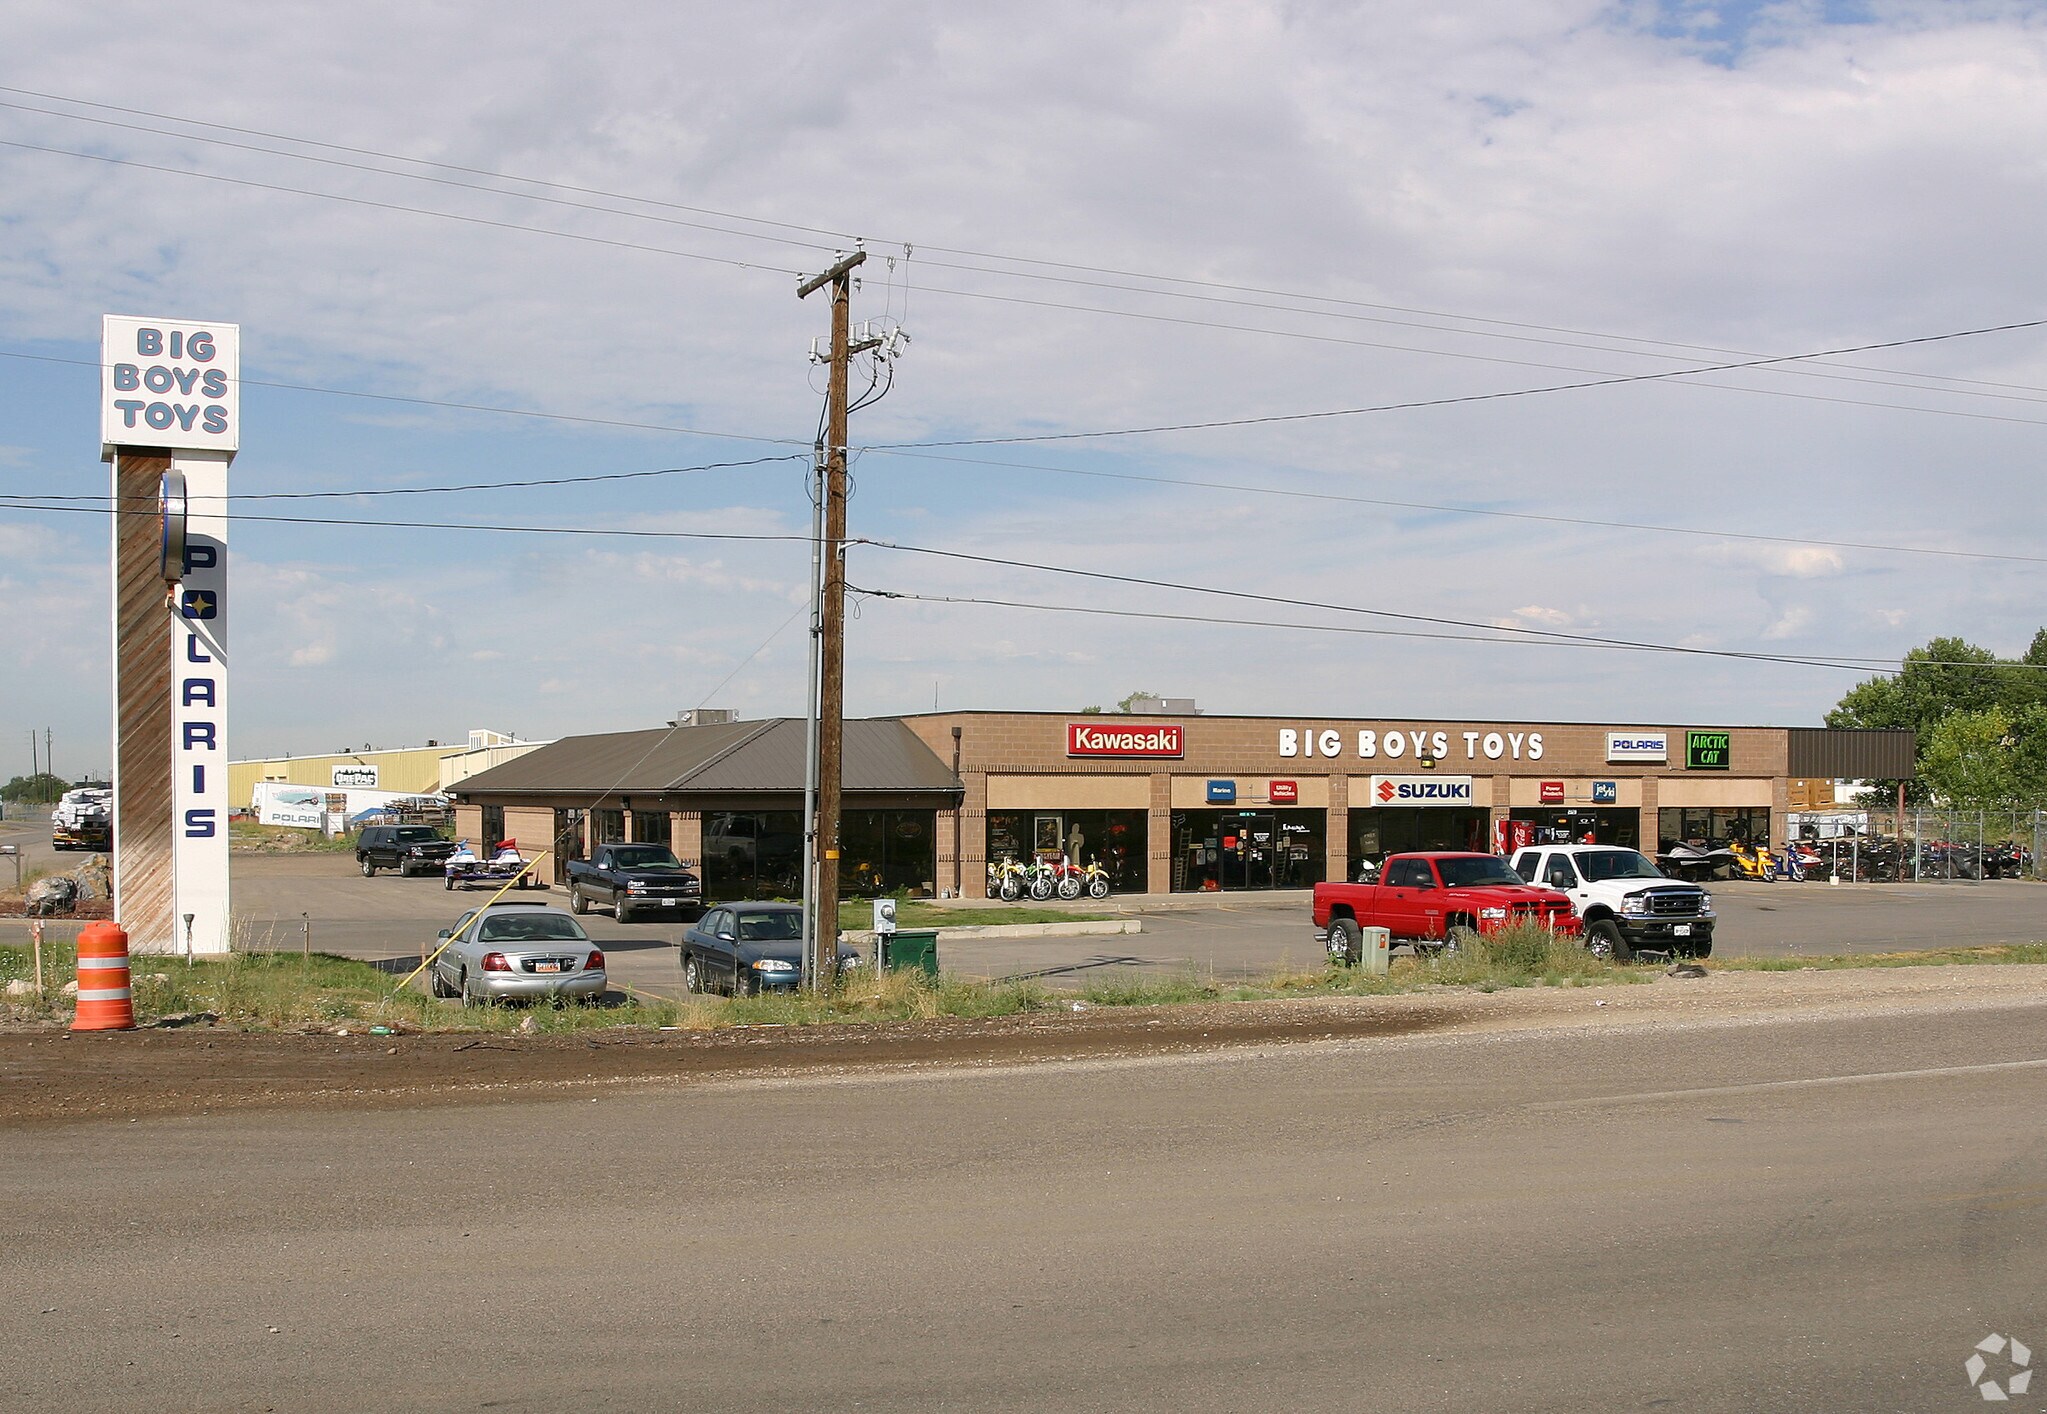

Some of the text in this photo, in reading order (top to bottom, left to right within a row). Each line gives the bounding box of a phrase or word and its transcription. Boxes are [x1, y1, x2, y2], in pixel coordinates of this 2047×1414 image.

[137, 327, 216, 362] BIG
[114, 363, 228, 398] BOYS
[114, 399, 228, 434] TOYS
[1075, 727, 1177, 750] Kawasaki
[1278, 728, 1544, 760] BIG BOYS TOYS
[1612, 740, 1664, 749] POLARIS
[1692, 735, 1728, 748] ARCTIC
[1700, 750, 1720, 763] CAT
[1398, 783, 1470, 798] SUZUKI
[272, 813, 321, 824] POLARI
